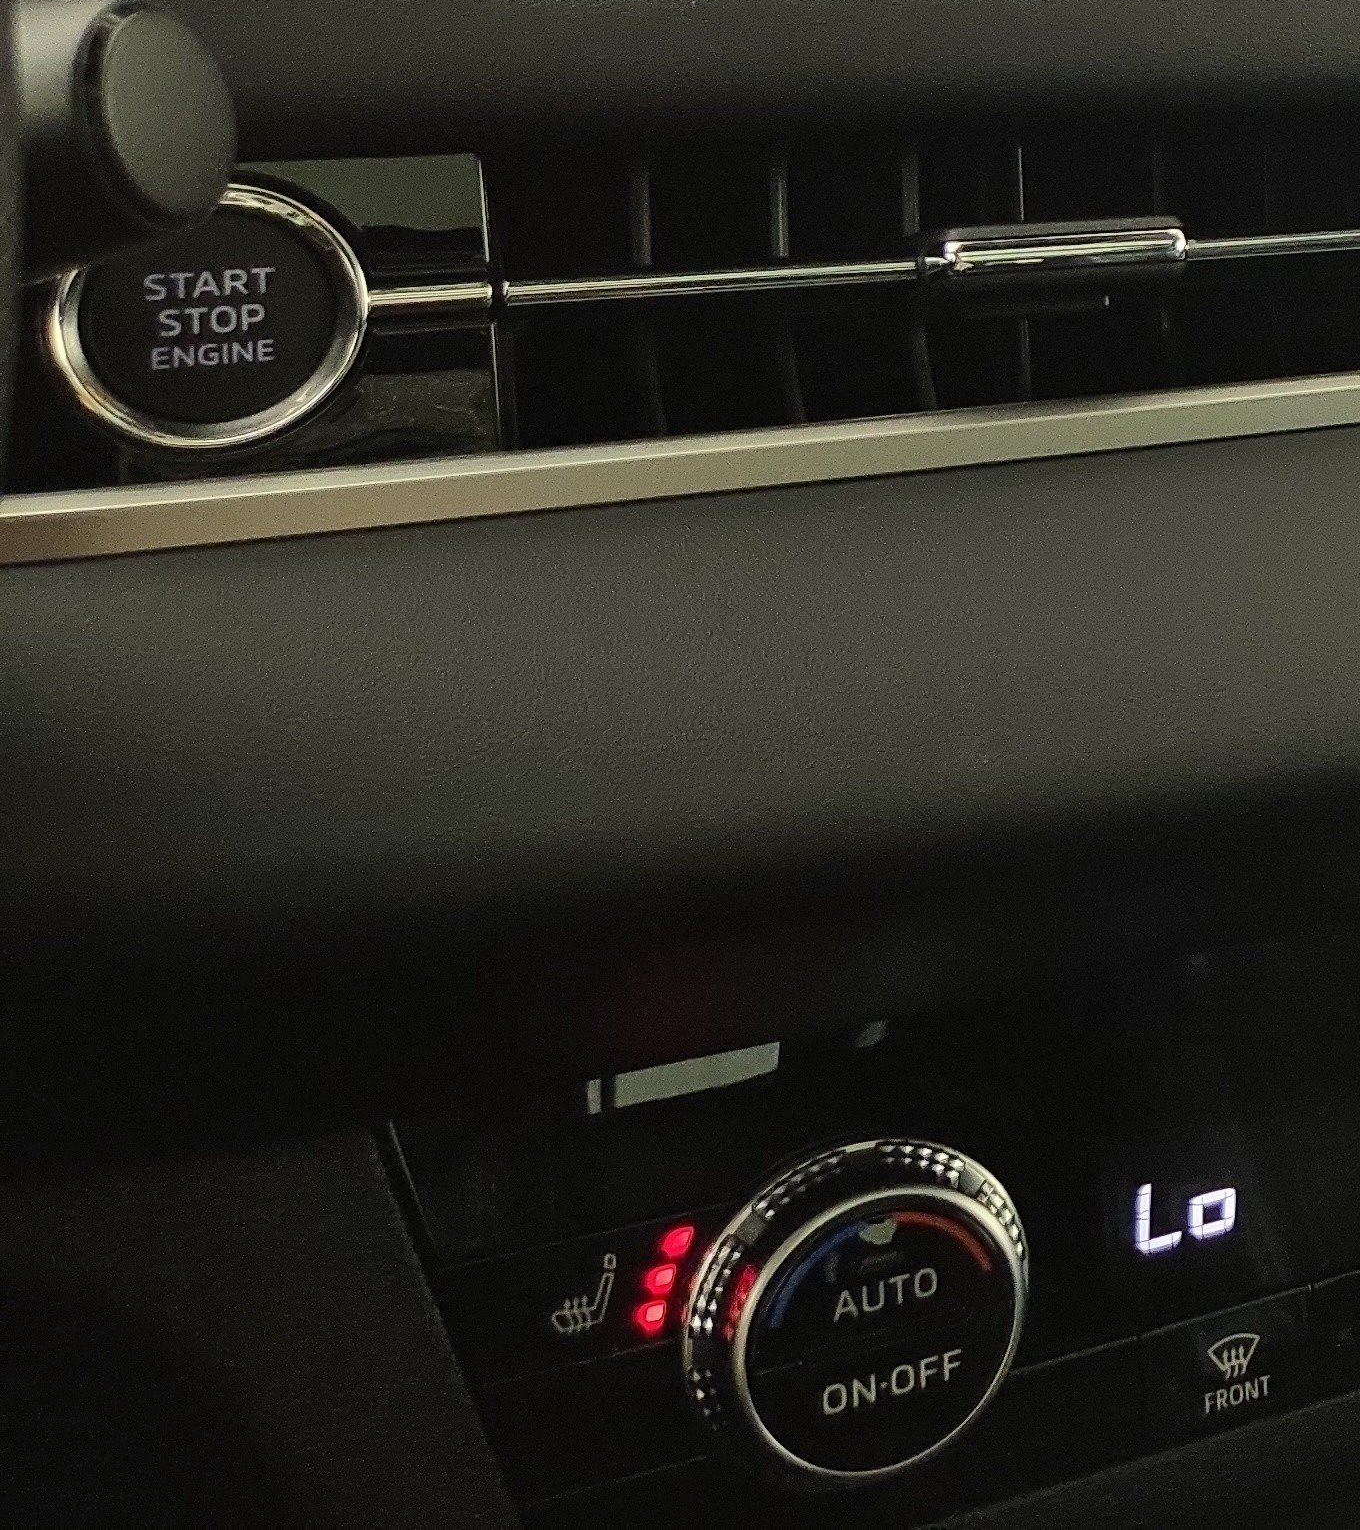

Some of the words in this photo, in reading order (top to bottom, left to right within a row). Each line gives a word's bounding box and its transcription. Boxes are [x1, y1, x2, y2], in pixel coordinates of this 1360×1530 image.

[143, 267, 276, 302] START
[158, 303, 266, 338] STOP
[151, 339, 275, 370] ENGINE
[1134, 1182, 1237, 1255] Lo
[834, 1267, 939, 1323] AUTO
[1203, 1374, 1271, 1415] FRONT
